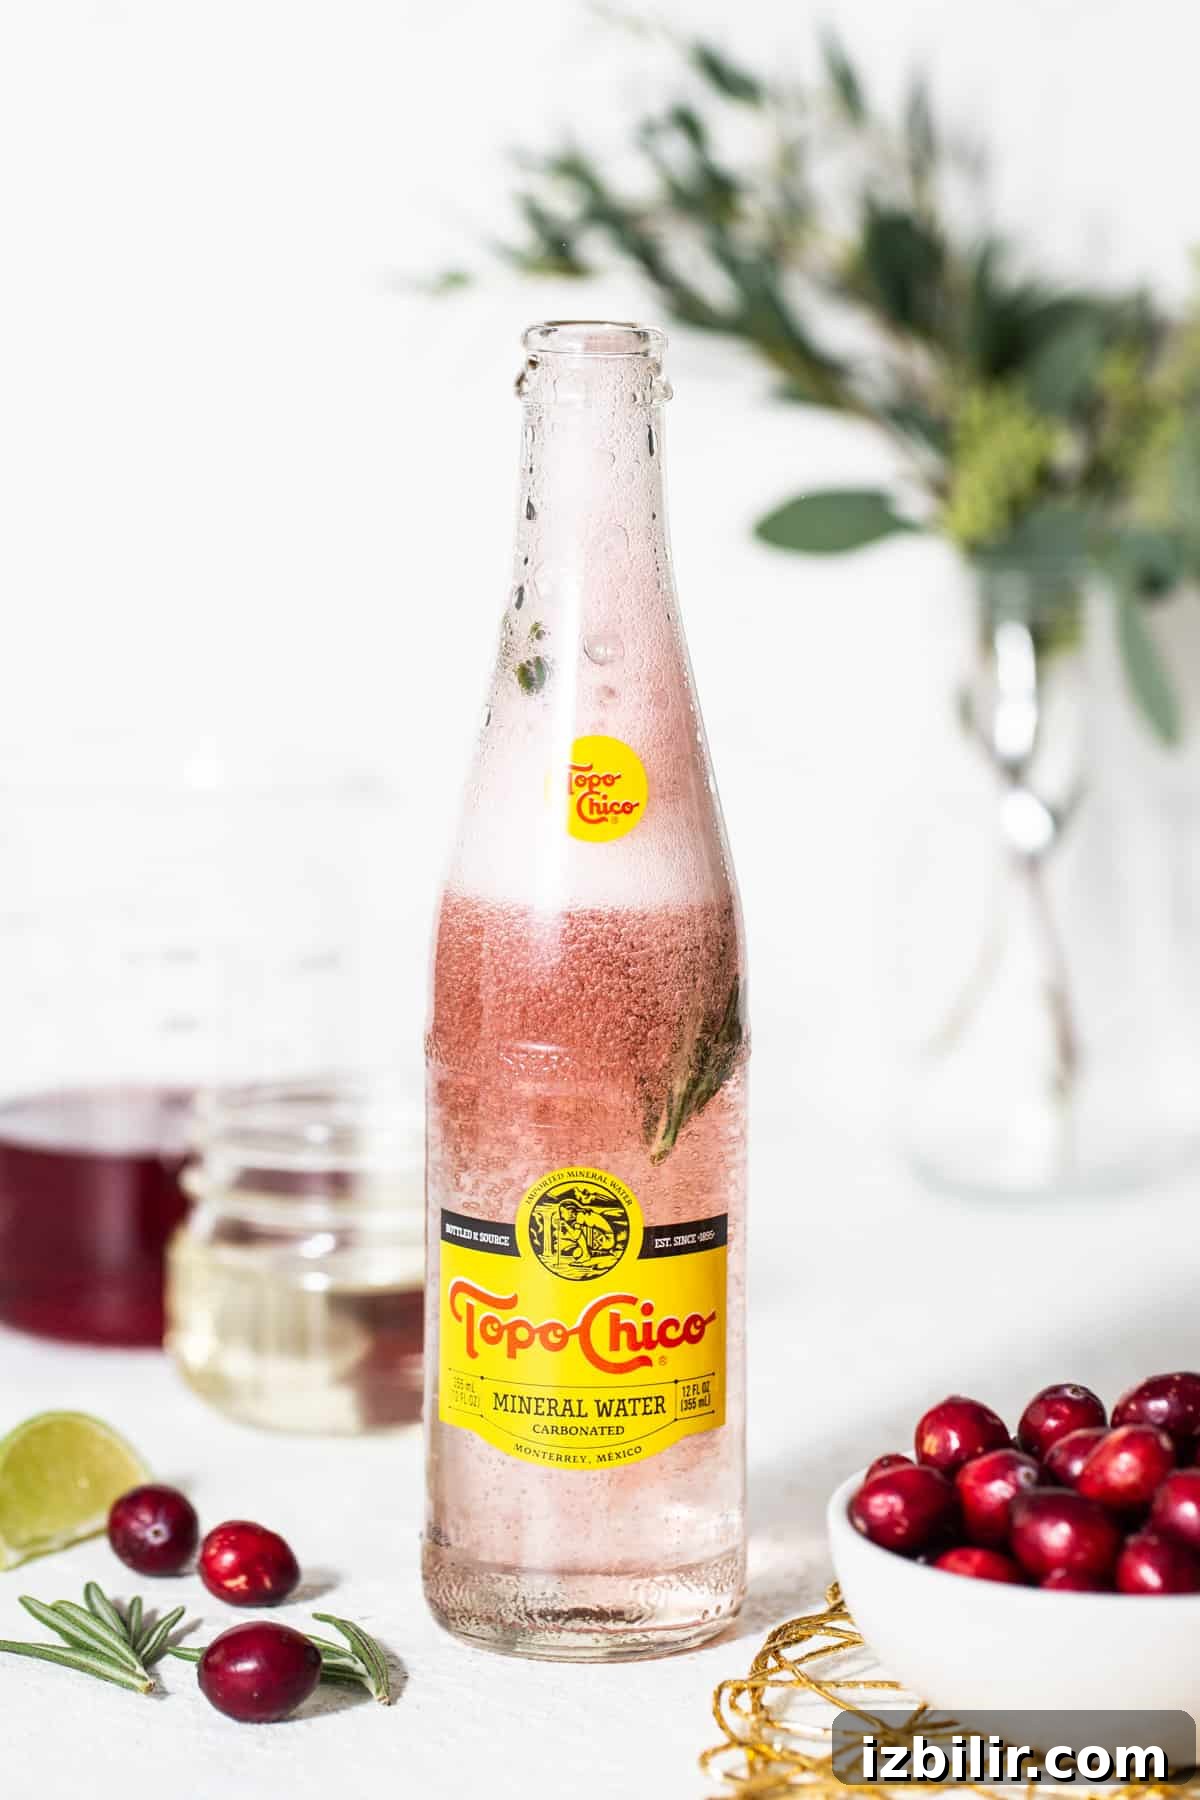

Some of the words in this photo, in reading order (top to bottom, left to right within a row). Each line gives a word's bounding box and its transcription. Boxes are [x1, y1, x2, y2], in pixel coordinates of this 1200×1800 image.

[576, 791, 640, 824] Chico
[567, 1170, 608, 1185] MINERAL
[609, 1179, 633, 1207] WATER
[445, 1223, 473, 1240] BOTTLED
[479, 1231, 510, 1247] SOURCE
[654, 1237, 673, 1249] EST.
[673, 1233, 697, 1247] SINCE
[449, 1280, 572, 1360] Topo
[577, 1294, 717, 1375] Chico
[682, 1385, 691, 1397] 12
[702, 1380, 710, 1393] OZ
[492, 1392, 588, 1419] MINERAL
[596, 1395, 667, 1419] WATER
[680, 1397, 697, 1412] (355
[532, 1424, 625, 1436] CARBONATED
[513, 1443, 592, 1465] MONTERREY,
